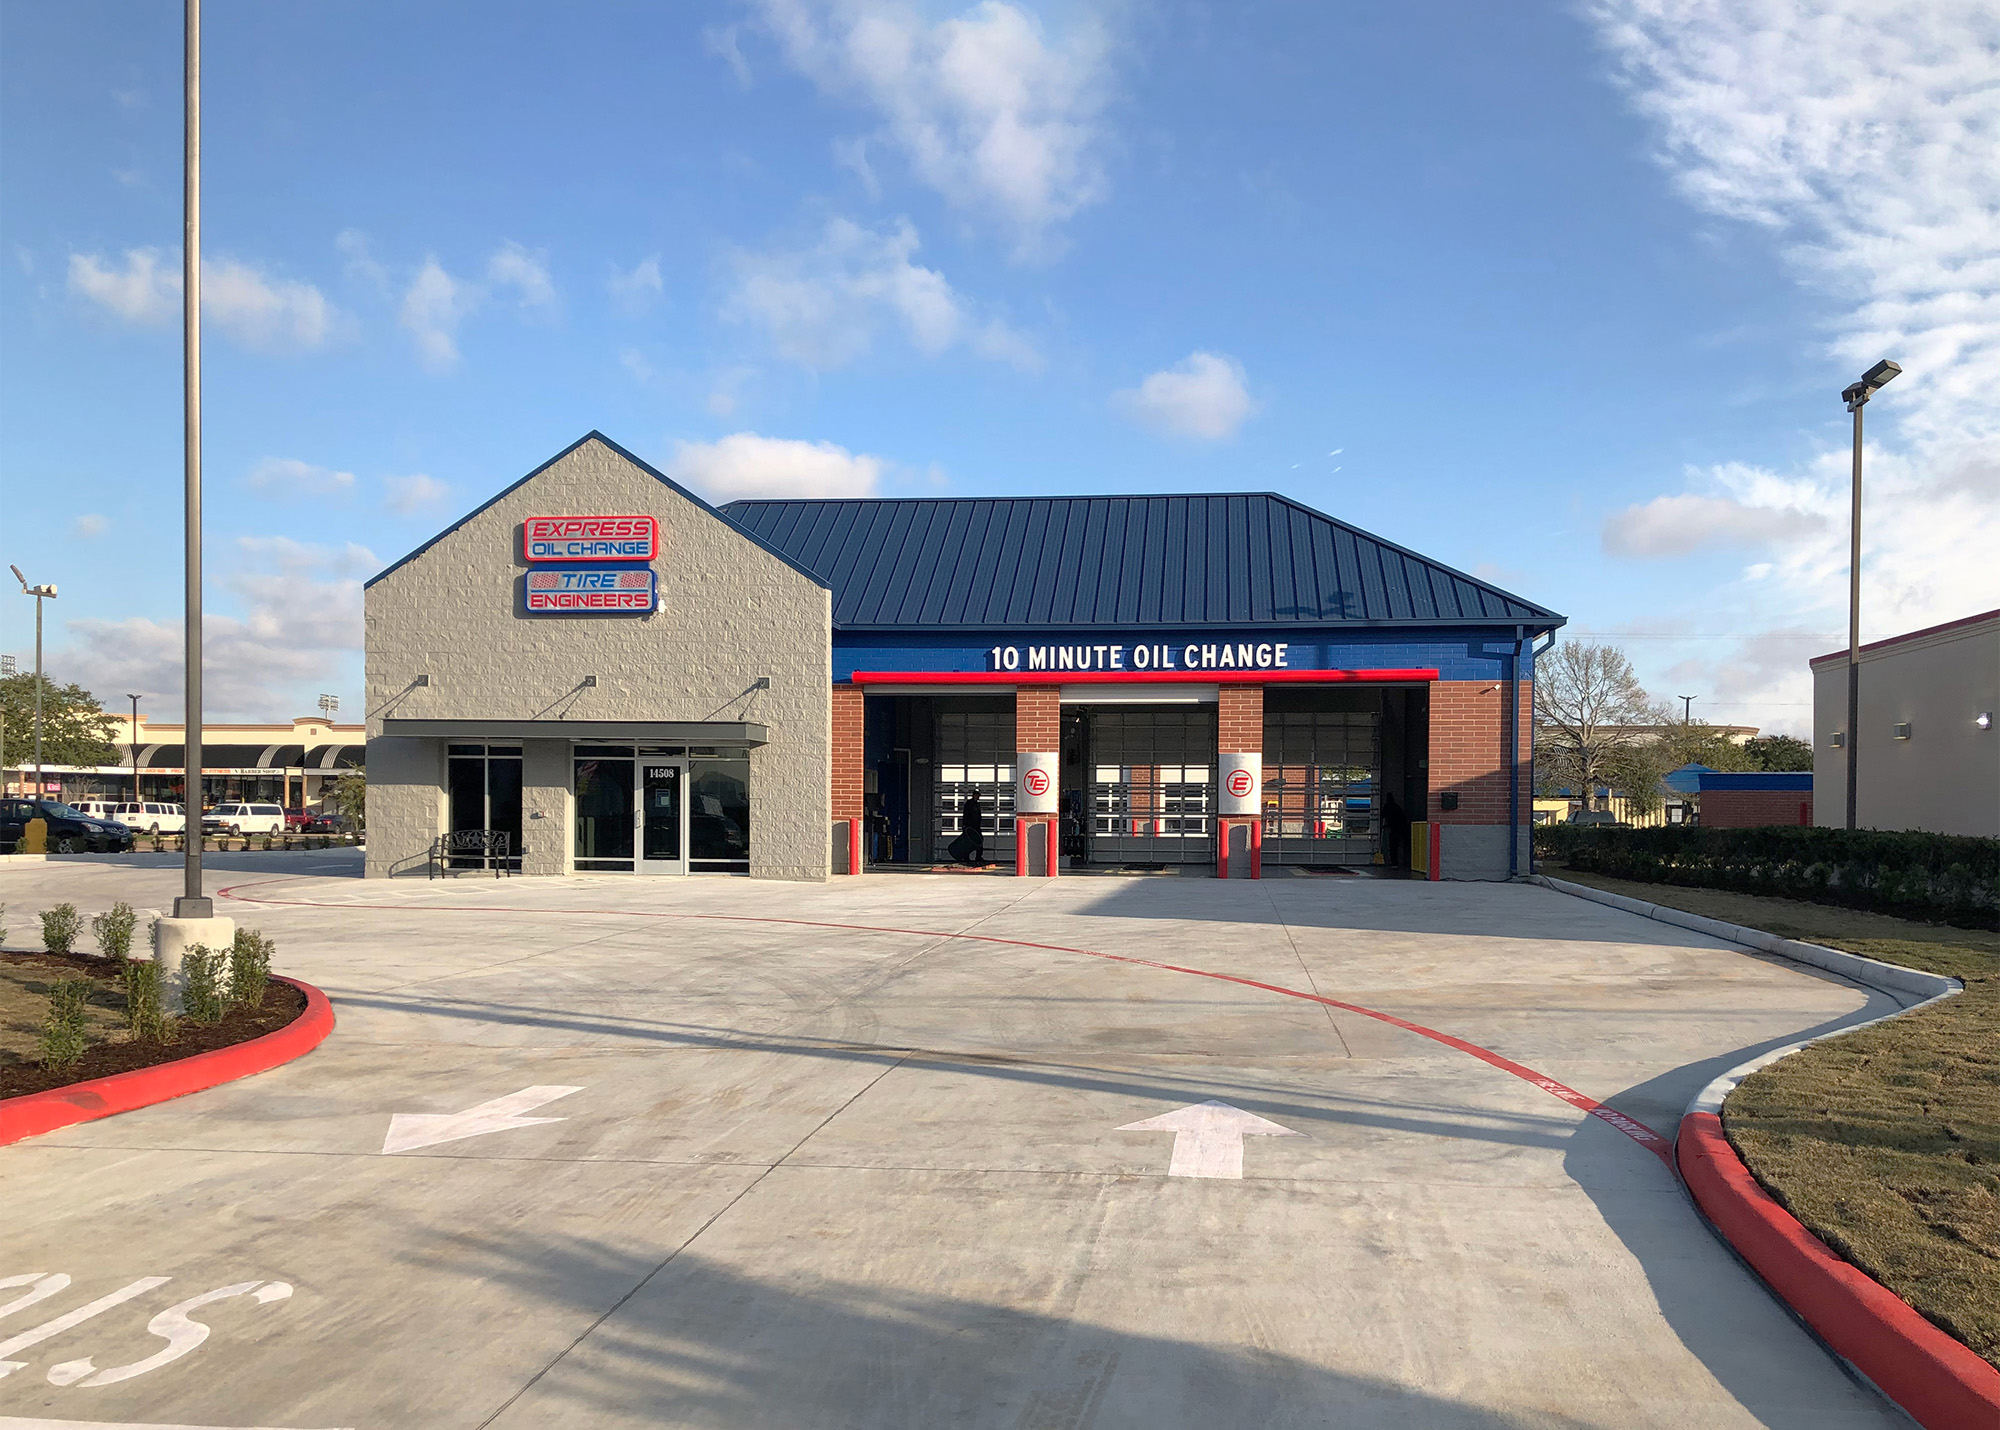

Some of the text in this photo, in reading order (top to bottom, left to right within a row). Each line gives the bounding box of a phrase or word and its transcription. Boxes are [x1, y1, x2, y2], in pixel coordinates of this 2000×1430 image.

[532, 521, 650, 537] EXPRESS
[532, 542, 649, 555] OIL CHANGE
[562, 573, 617, 588] TIRE
[530, 594, 648, 607] ENGINEERS
[992, 643, 1288, 670] 10 MINUTE OIL CHANGE
[649, 768, 675, 778] 14508
[1027, 775, 1047, 790] TE
[1232, 776, 1249, 790] E
